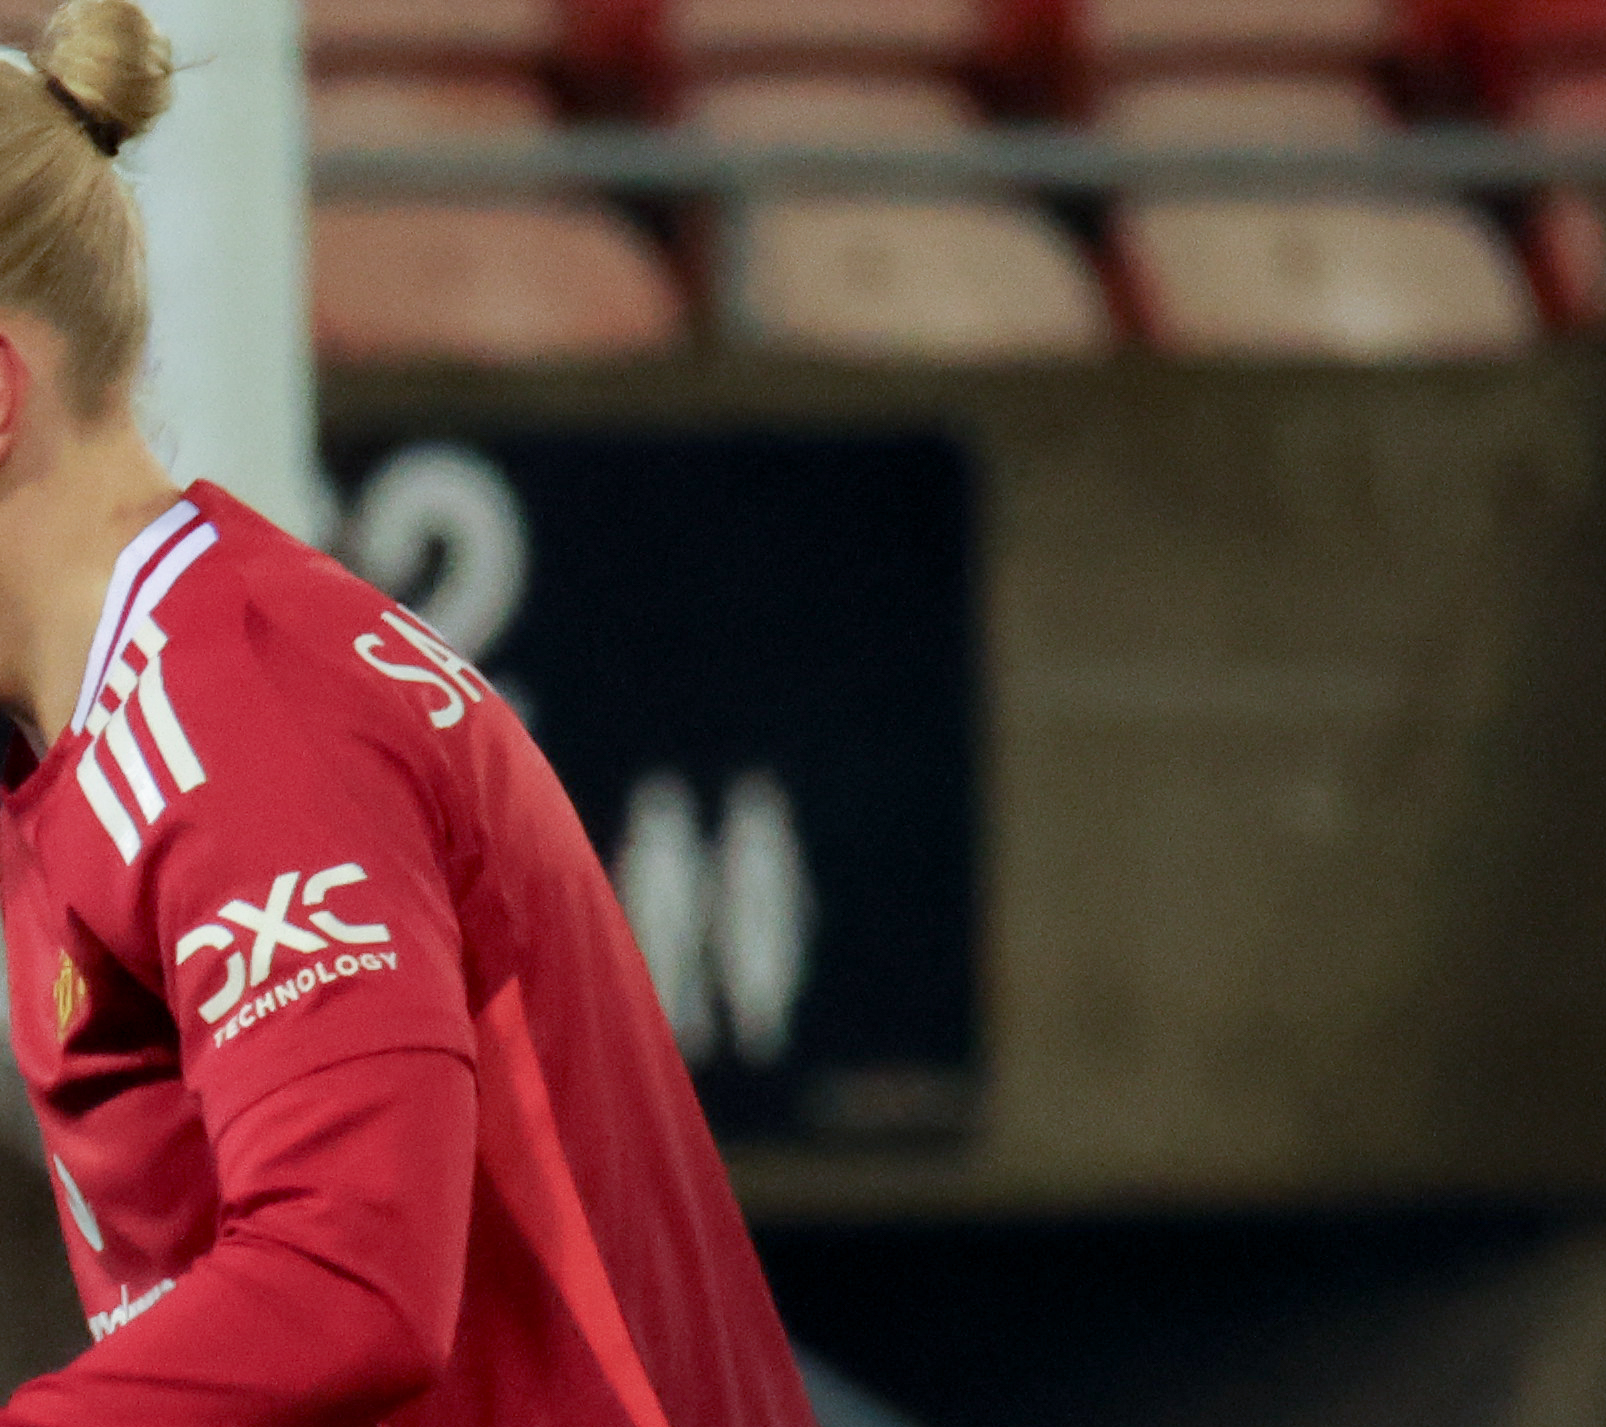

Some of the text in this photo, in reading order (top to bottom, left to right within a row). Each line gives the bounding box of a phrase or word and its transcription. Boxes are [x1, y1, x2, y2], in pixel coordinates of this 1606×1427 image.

[329, 438, 532, 690] 2
[176, 862, 391, 1025] DXC
[213, 950, 398, 1049] TECHNOLOGY
